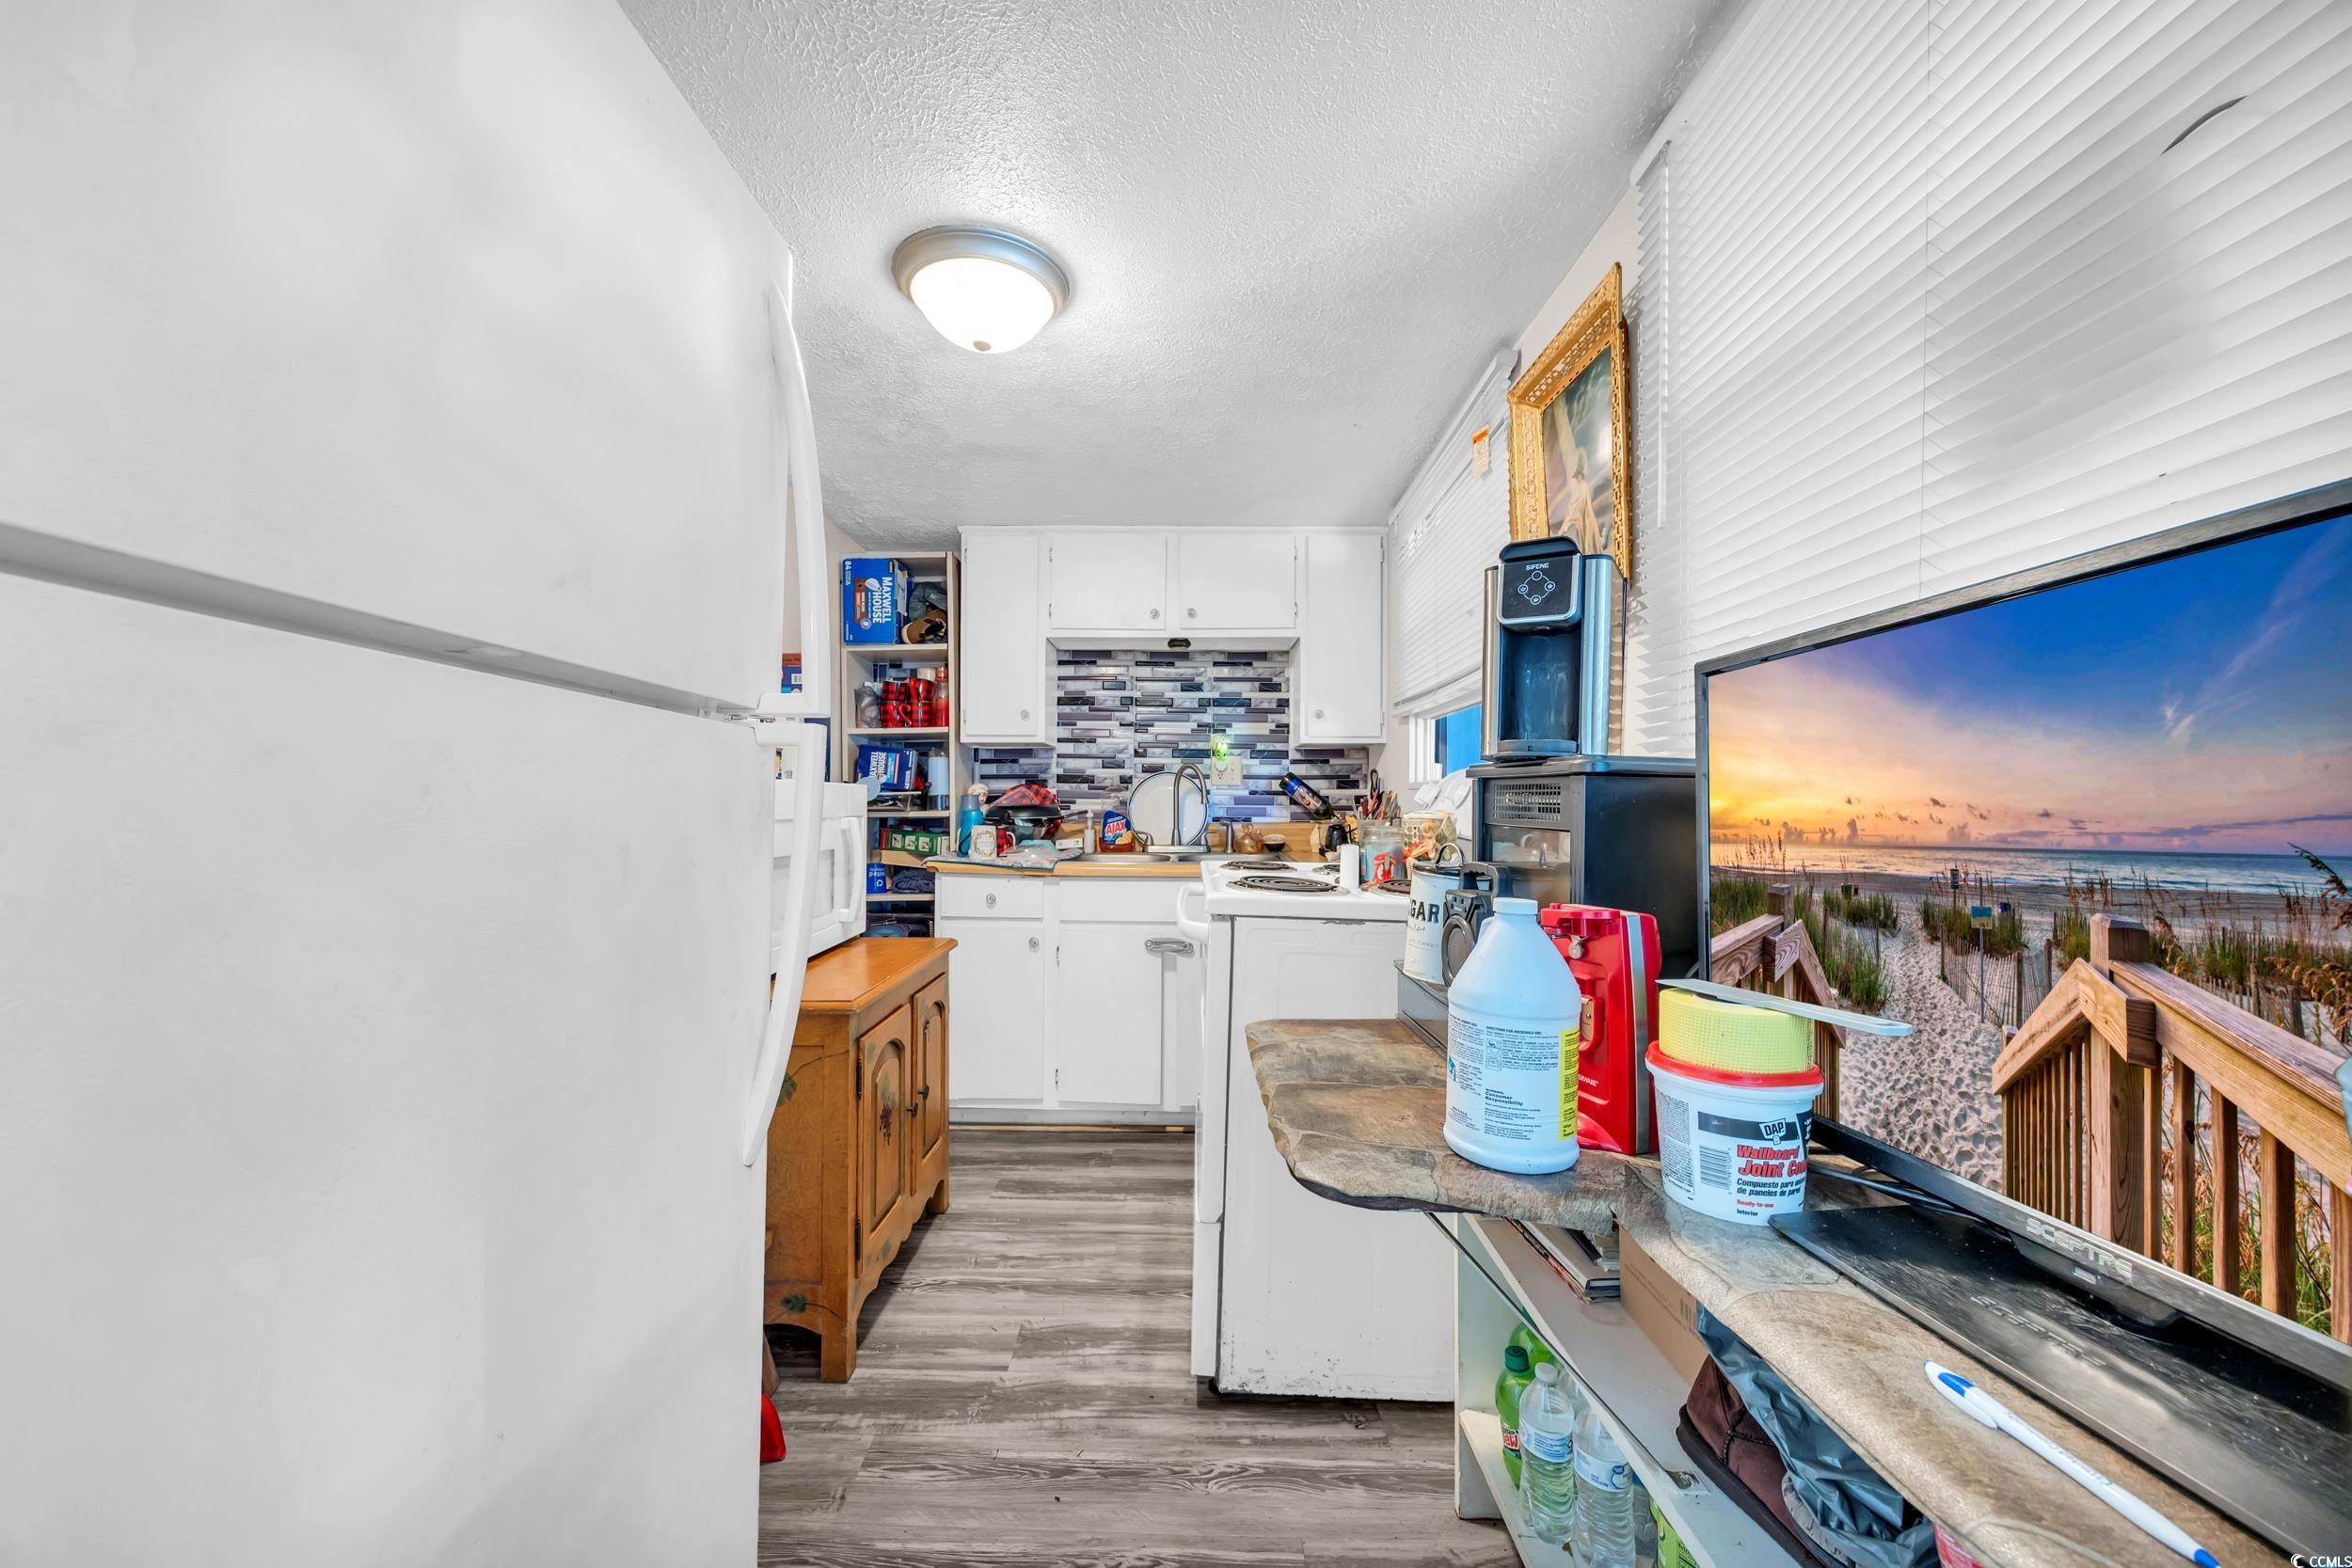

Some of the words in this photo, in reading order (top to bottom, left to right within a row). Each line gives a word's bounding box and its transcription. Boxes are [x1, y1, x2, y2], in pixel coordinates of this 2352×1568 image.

[872, 591, 882, 624] HOUSE
[882, 577, 893, 624] MAXWELL
[1107, 820, 1125, 835] AJAX
[1409, 898, 1440, 925] GAR
[1486, 1091, 1513, 1101] Consumer
[1486, 1096, 1523, 1106] Responsibility
[1737, 1144, 1801, 1161] Wallboard
[1738, 1160, 1785, 1178] Joint
[1737, 1179, 1779, 1189] Compuesto
[1749, 1188, 1778, 1197] paneles
[1779, 1189, 1788, 1197] de
[2026, 1217, 2134, 1280] SCEPTRE
